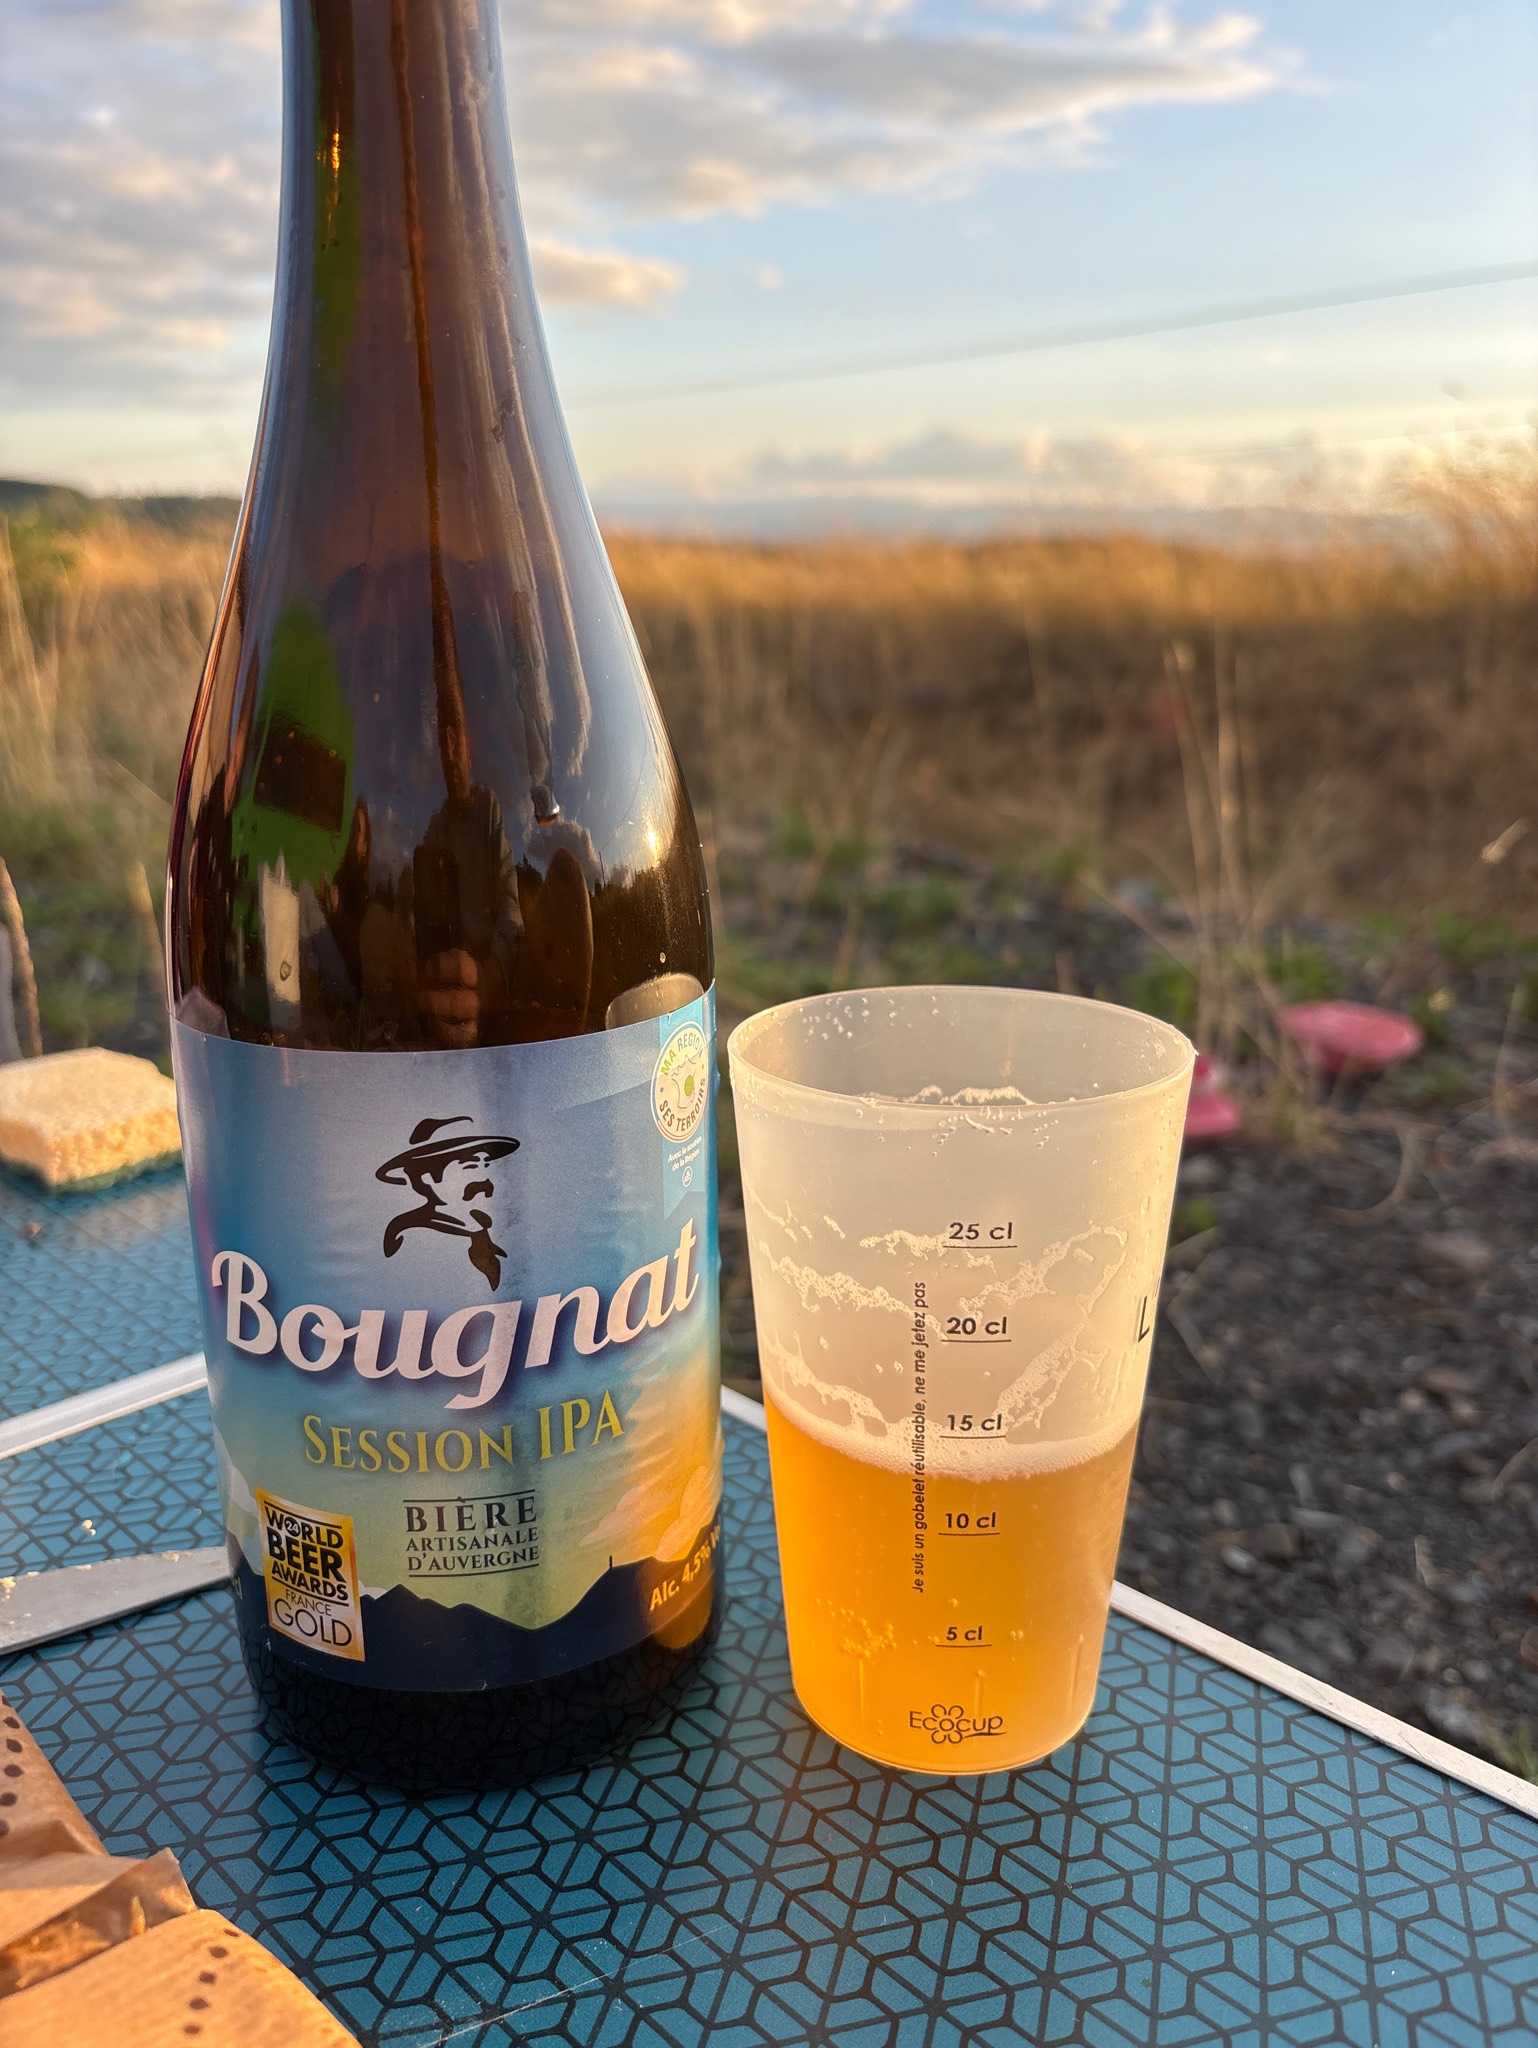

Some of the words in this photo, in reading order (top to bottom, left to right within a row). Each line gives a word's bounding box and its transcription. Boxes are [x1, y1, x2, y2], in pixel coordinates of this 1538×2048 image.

[660, 1049, 677, 1076] MA
[659, 1100, 675, 1127] SES
[676, 1078, 705, 1132] TERROIRS
[949, 1222, 980, 1240] 25
[989, 1222, 1014, 1240] cl
[914, 1282, 929, 1309] pas
[212, 1218, 701, 1410] Bougnat
[946, 1317, 977, 1335] 20
[984, 1316, 1008, 1335] cl
[911, 1312, 929, 1348] jetez
[914, 1349, 926, 1373] me
[914, 1376, 926, 1395] ne
[302, 1415, 515, 1474] SESSION
[537, 1389, 625, 1462] IPA
[947, 1414, 974, 1431] 15
[980, 1413, 1003, 1431] cl
[911, 1399, 928, 1476] réutilisable,
[404, 1496, 538, 1532] BIÈRE
[912, 1479, 928, 1530] gobelet
[945, 1512, 970, 1529] 10
[976, 1512, 997, 1529] cl
[405, 1527, 539, 1551] ARTISANALE
[914, 1533, 925, 1549] un
[266, 1526, 347, 1583] BEER
[407, 1546, 540, 1571] D'AUVERGNE
[912, 1552, 924, 1576] suis
[271, 1561, 349, 1601] AWARDS
[912, 1578, 924, 1593] Je
[285, 1589, 333, 1617] FRANCE
[649, 1580, 680, 1611] Alc.
[274, 1598, 353, 1647] GOLD
[946, 1627, 958, 1641] 5
[964, 1626, 983, 1641] cl
